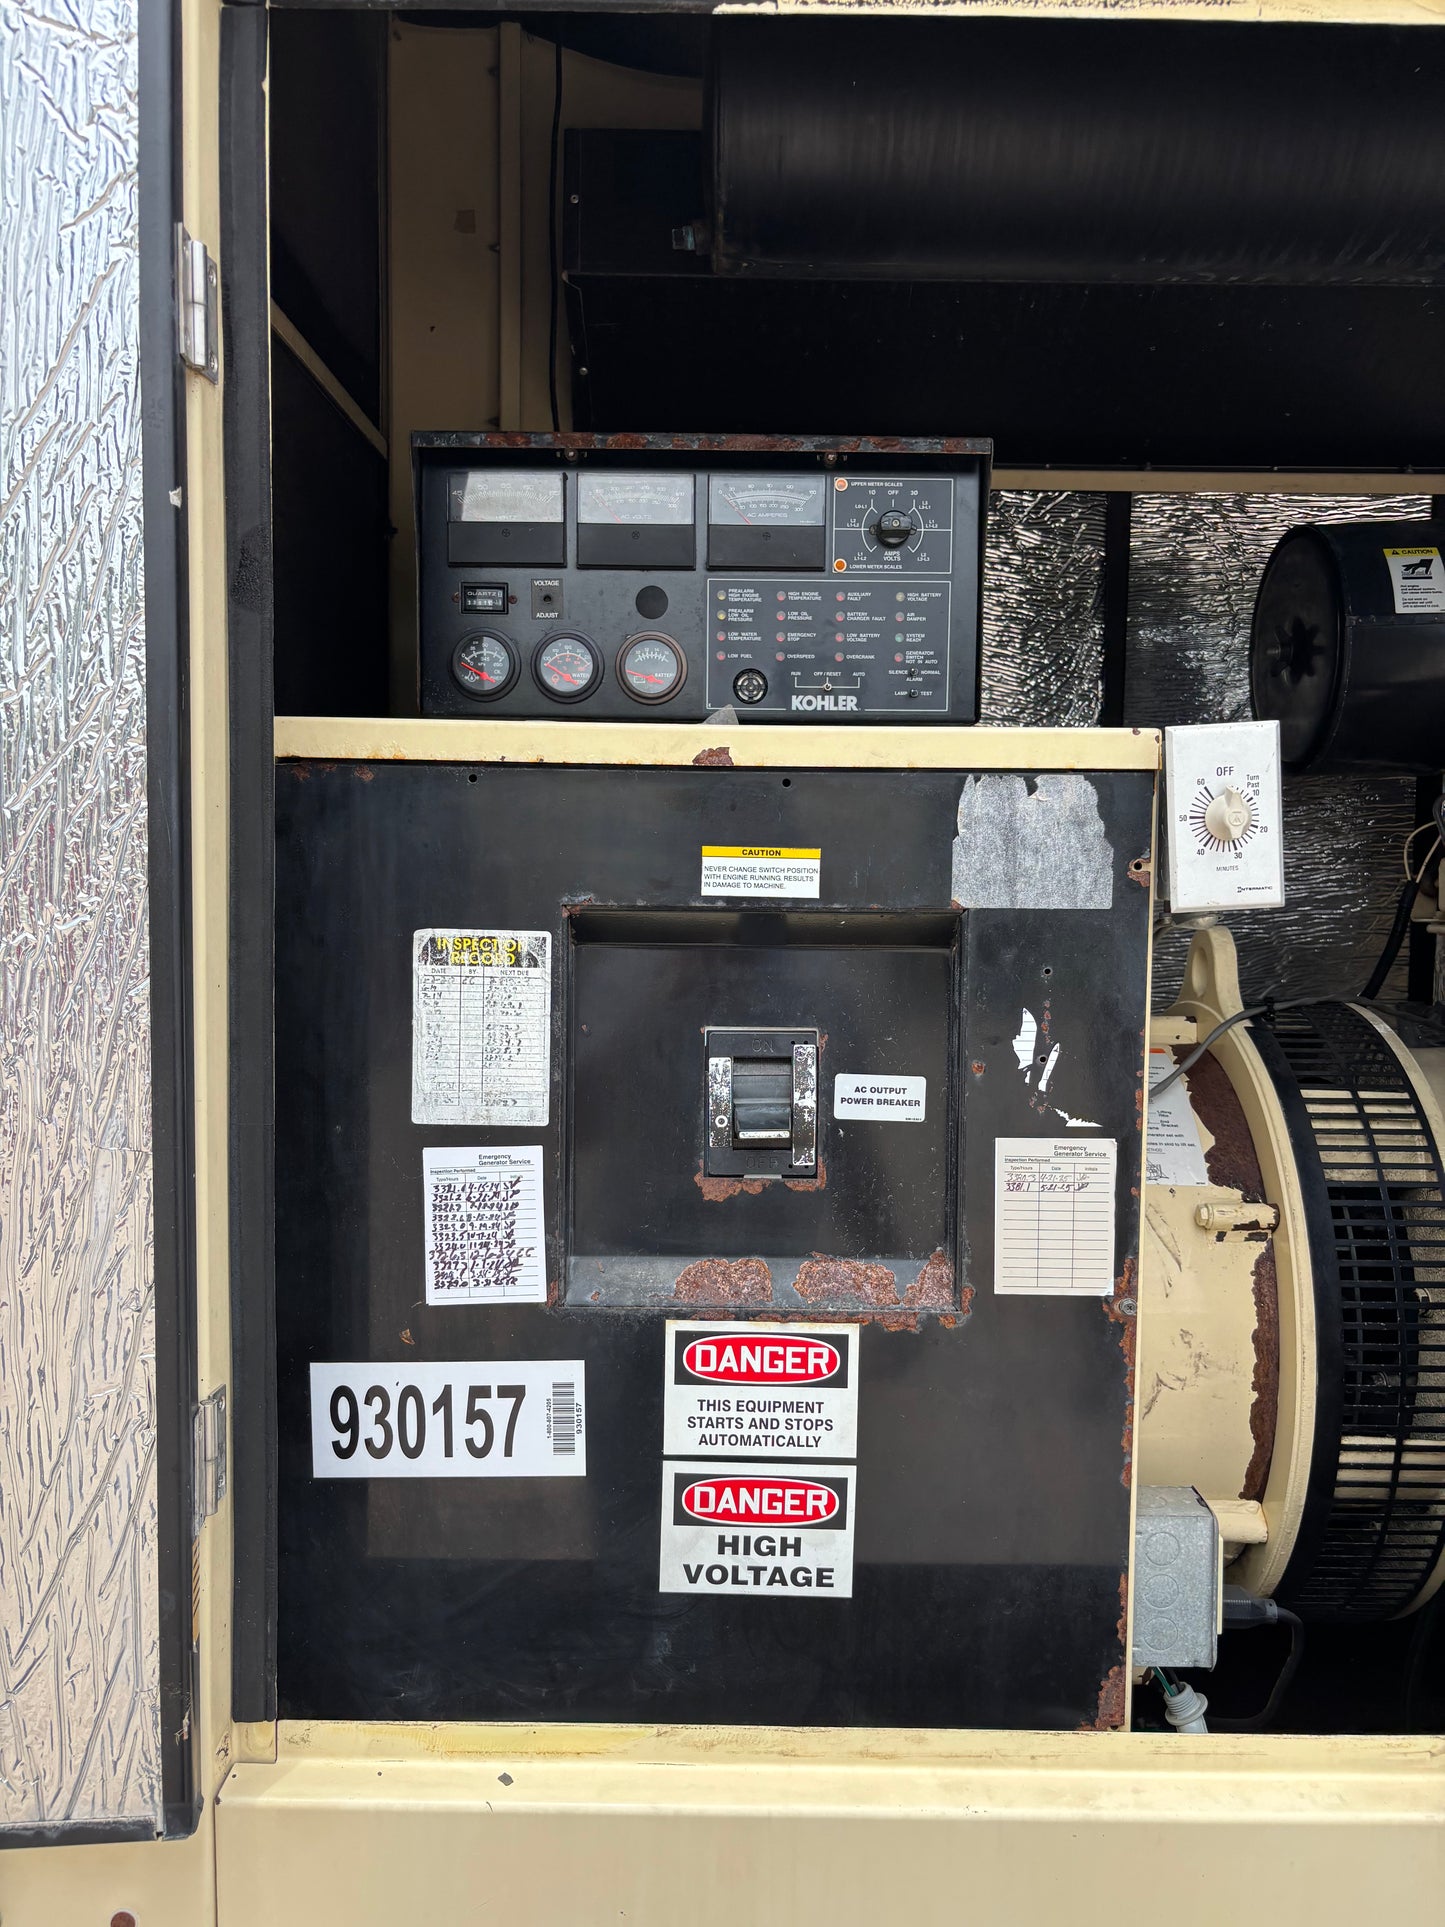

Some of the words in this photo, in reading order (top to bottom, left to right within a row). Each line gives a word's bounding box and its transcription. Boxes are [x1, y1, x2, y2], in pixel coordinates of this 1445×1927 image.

[792, 695, 858, 710] KOHLER
[1216, 766, 1234, 776] OFF
[752, 1038, 774, 1052] ON
[840, 1097, 874, 1105] POWER
[876, 1098, 920, 1107] BREAKER
[746, 1156, 778, 1169] OFF
[695, 1344, 830, 1375] DANGER
[697, 1399, 731, 1412] THIS
[736, 1400, 824, 1414] EQUIPMENT
[330, 1384, 526, 1460] 930157
[688, 1416, 744, 1429] STARTS
[748, 1418, 780, 1430] AND
[784, 1418, 833, 1431] STOPS
[698, 1434, 822, 1448] AUTOMATICALLY
[694, 1486, 829, 1516] DANGER
[718, 1534, 801, 1557] HIGH
[683, 1564, 834, 1588] VOLTAGE
